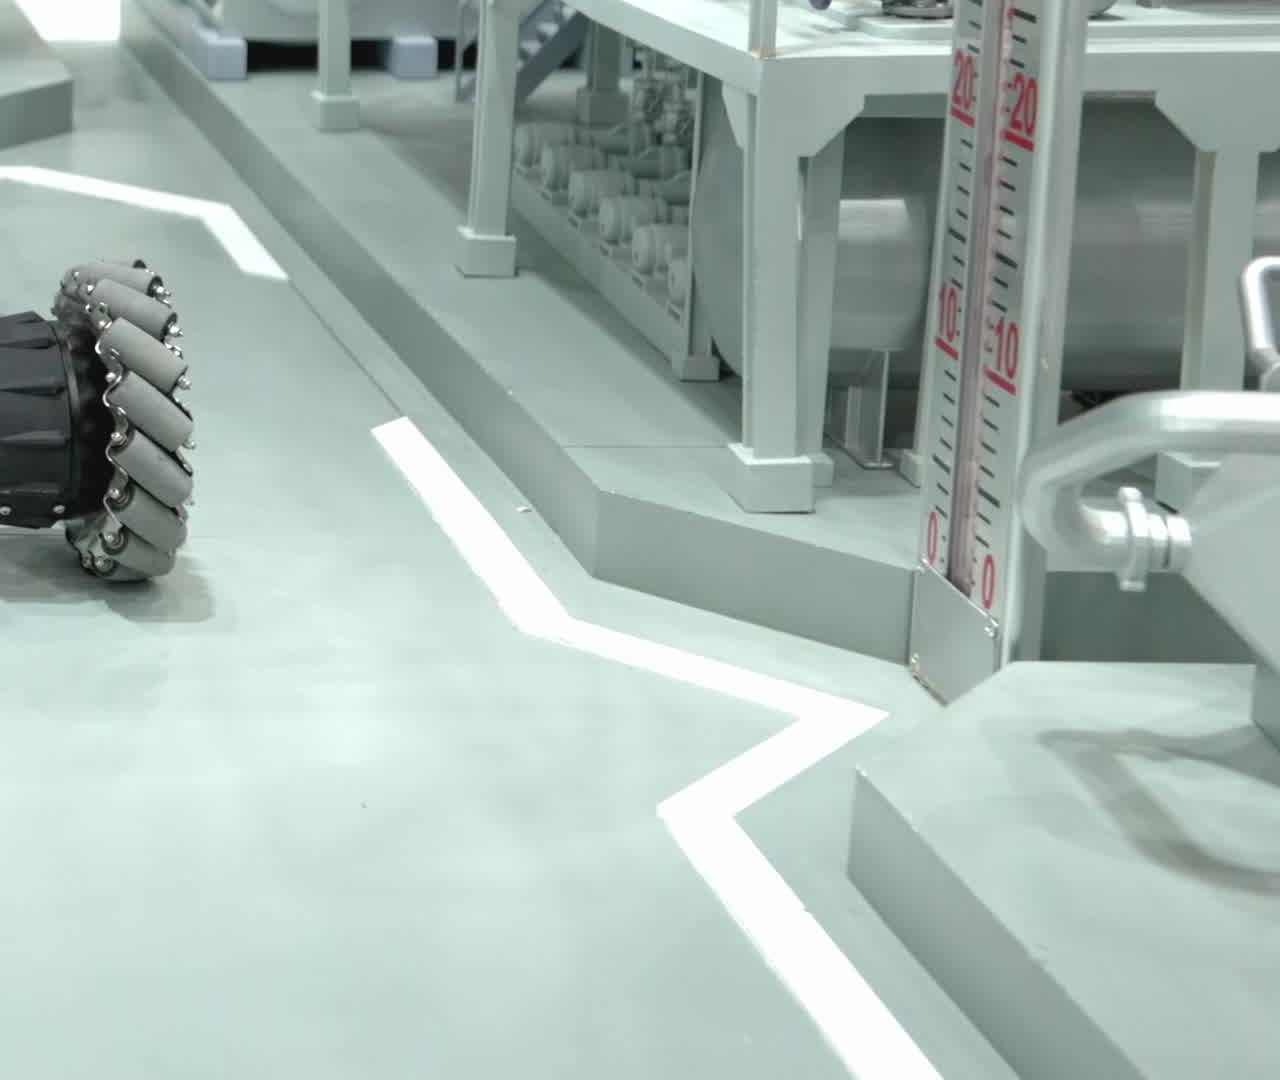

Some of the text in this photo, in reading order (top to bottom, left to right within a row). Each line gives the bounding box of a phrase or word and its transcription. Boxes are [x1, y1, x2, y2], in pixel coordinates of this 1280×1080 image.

[951, 50, 976, 110] 20
[1008, 71, 1038, 137] 20
[939, 281, 957, 342] 10
[996, 316, 1019, 379] 10
[927, 511, 938, 563] 0
[981, 554, 995, 609] 0
